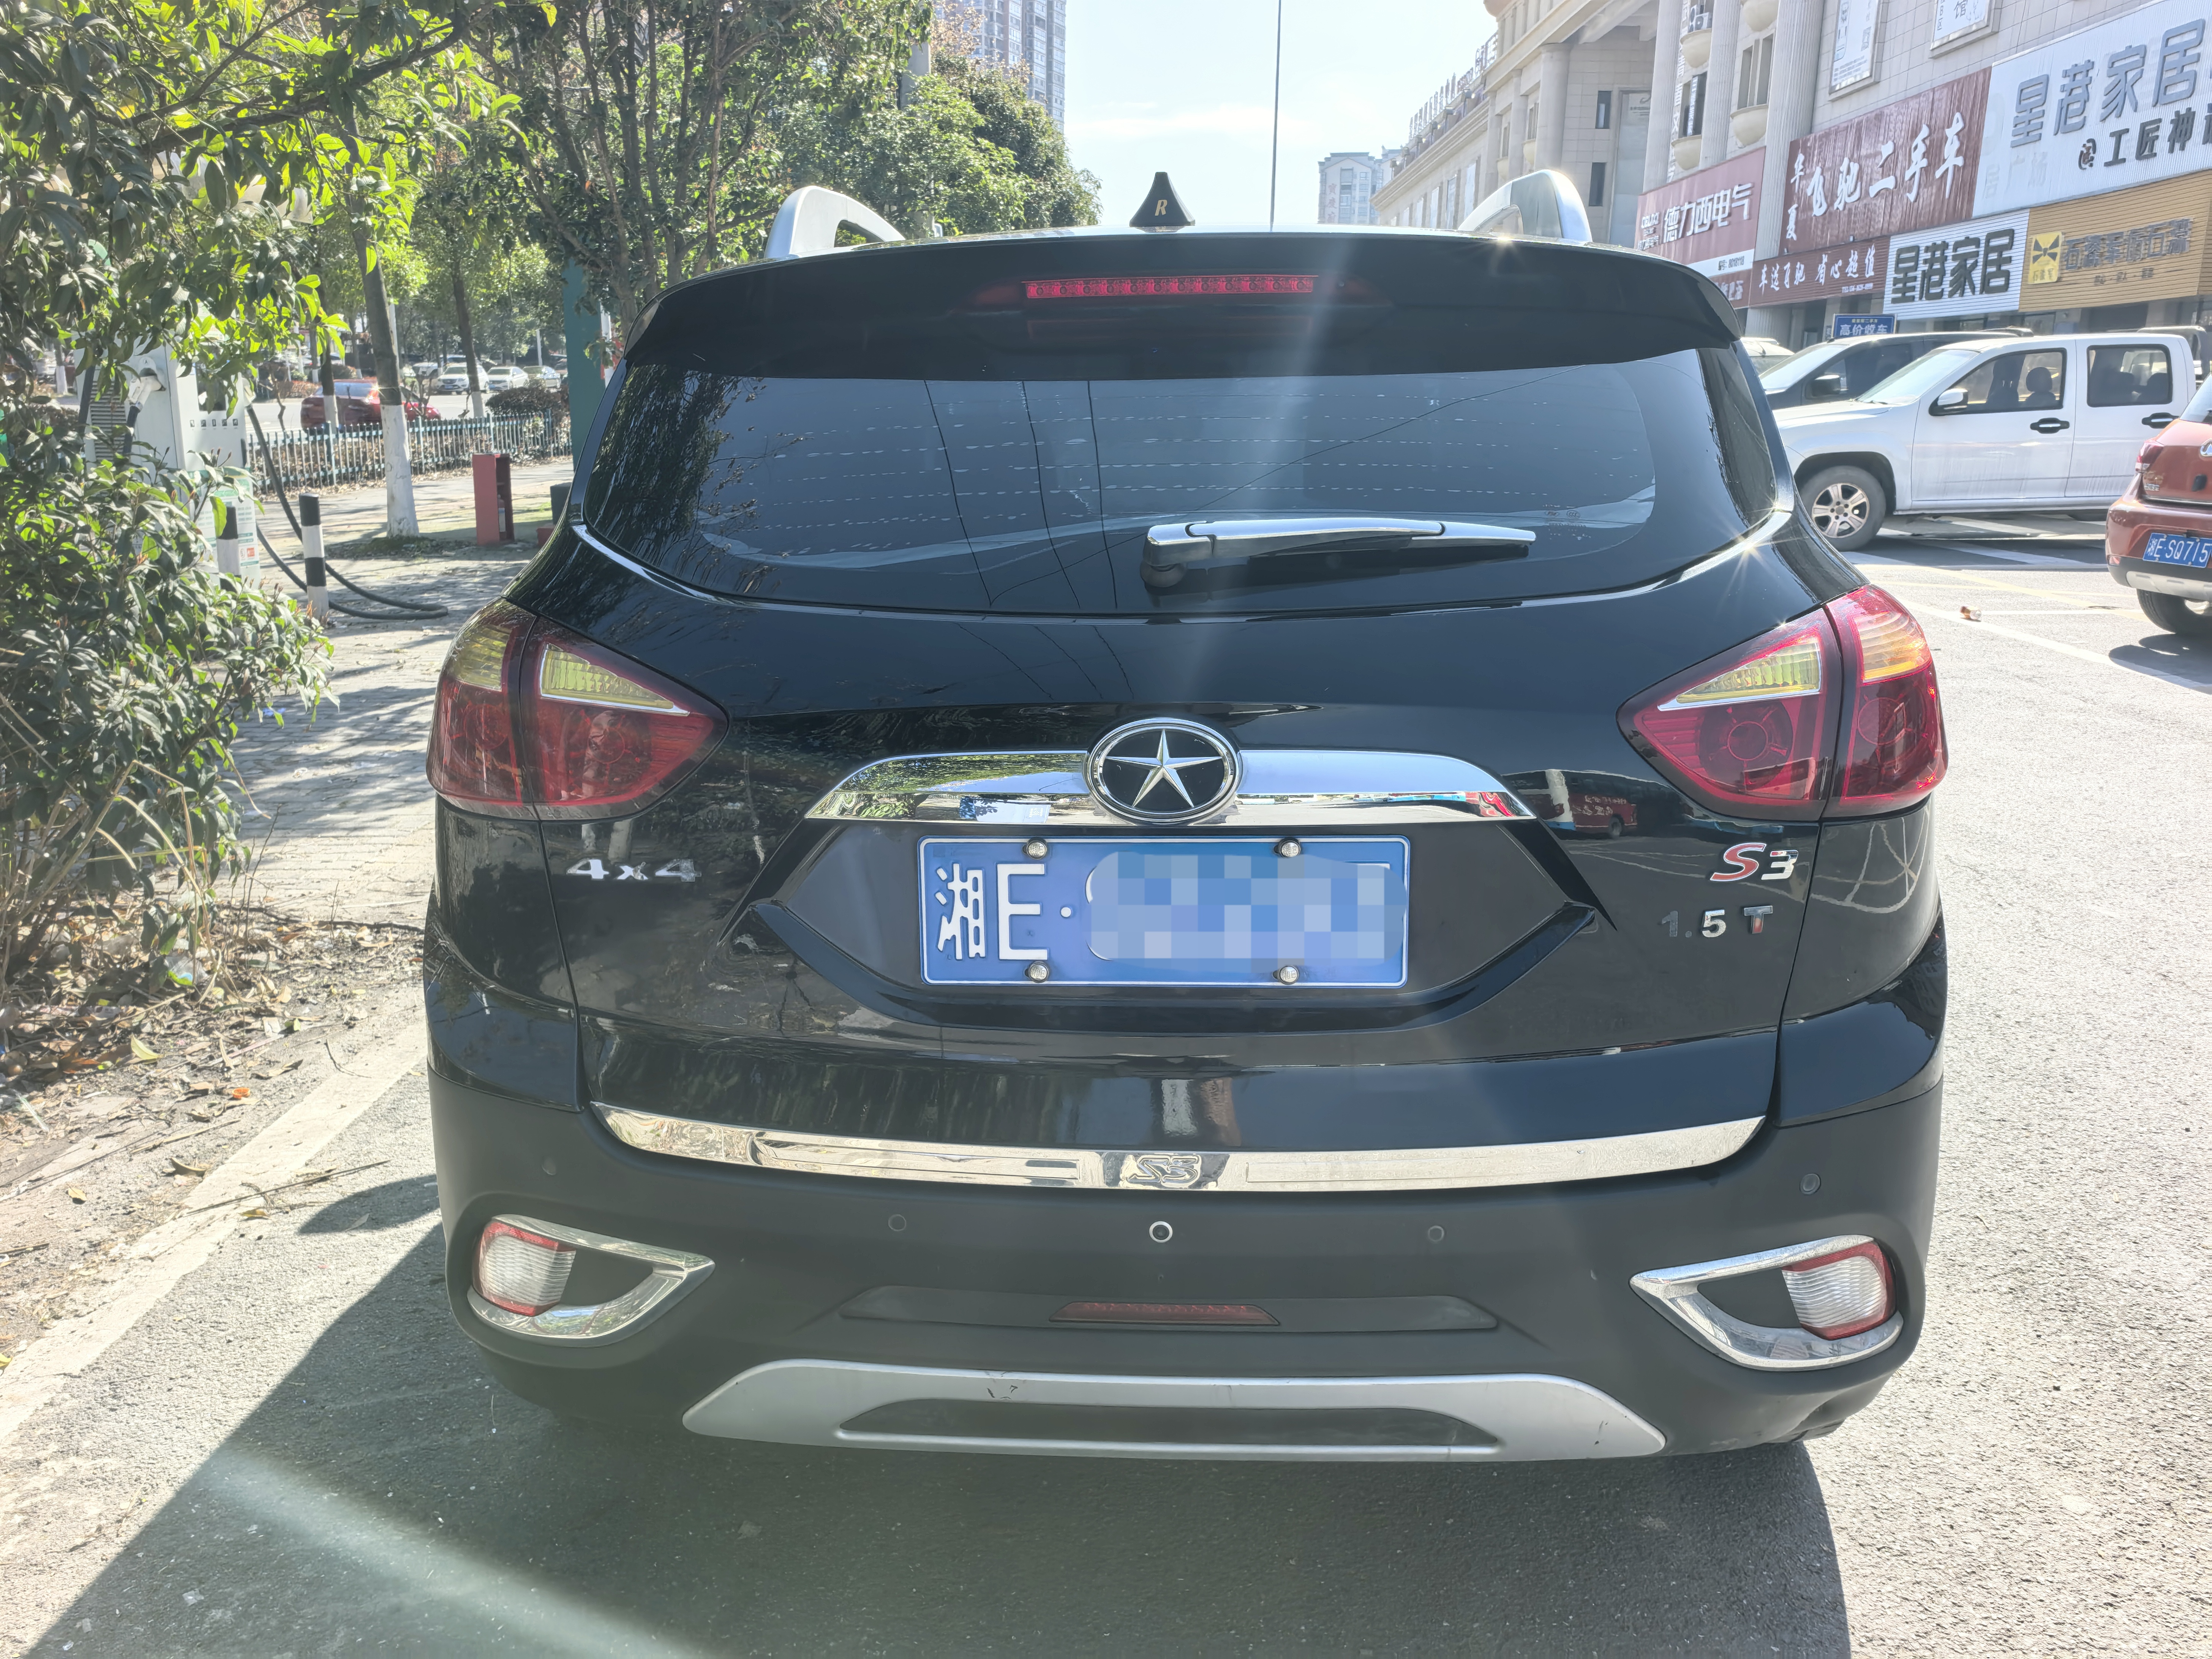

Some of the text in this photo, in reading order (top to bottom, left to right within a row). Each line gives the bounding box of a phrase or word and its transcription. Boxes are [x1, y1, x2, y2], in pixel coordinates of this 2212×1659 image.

[2010, 18, 2206, 149] 星港家居
[1806, 112, 1964, 217] 飞驰二手车
[1155, 199, 1168, 216] R
[1663, 182, 1755, 243] 德力西电气
[1891, 229, 2014, 304] 星港家居
[1839, 324, 1888, 336] 高价收车
[1710, 842, 1799, 882] S3
